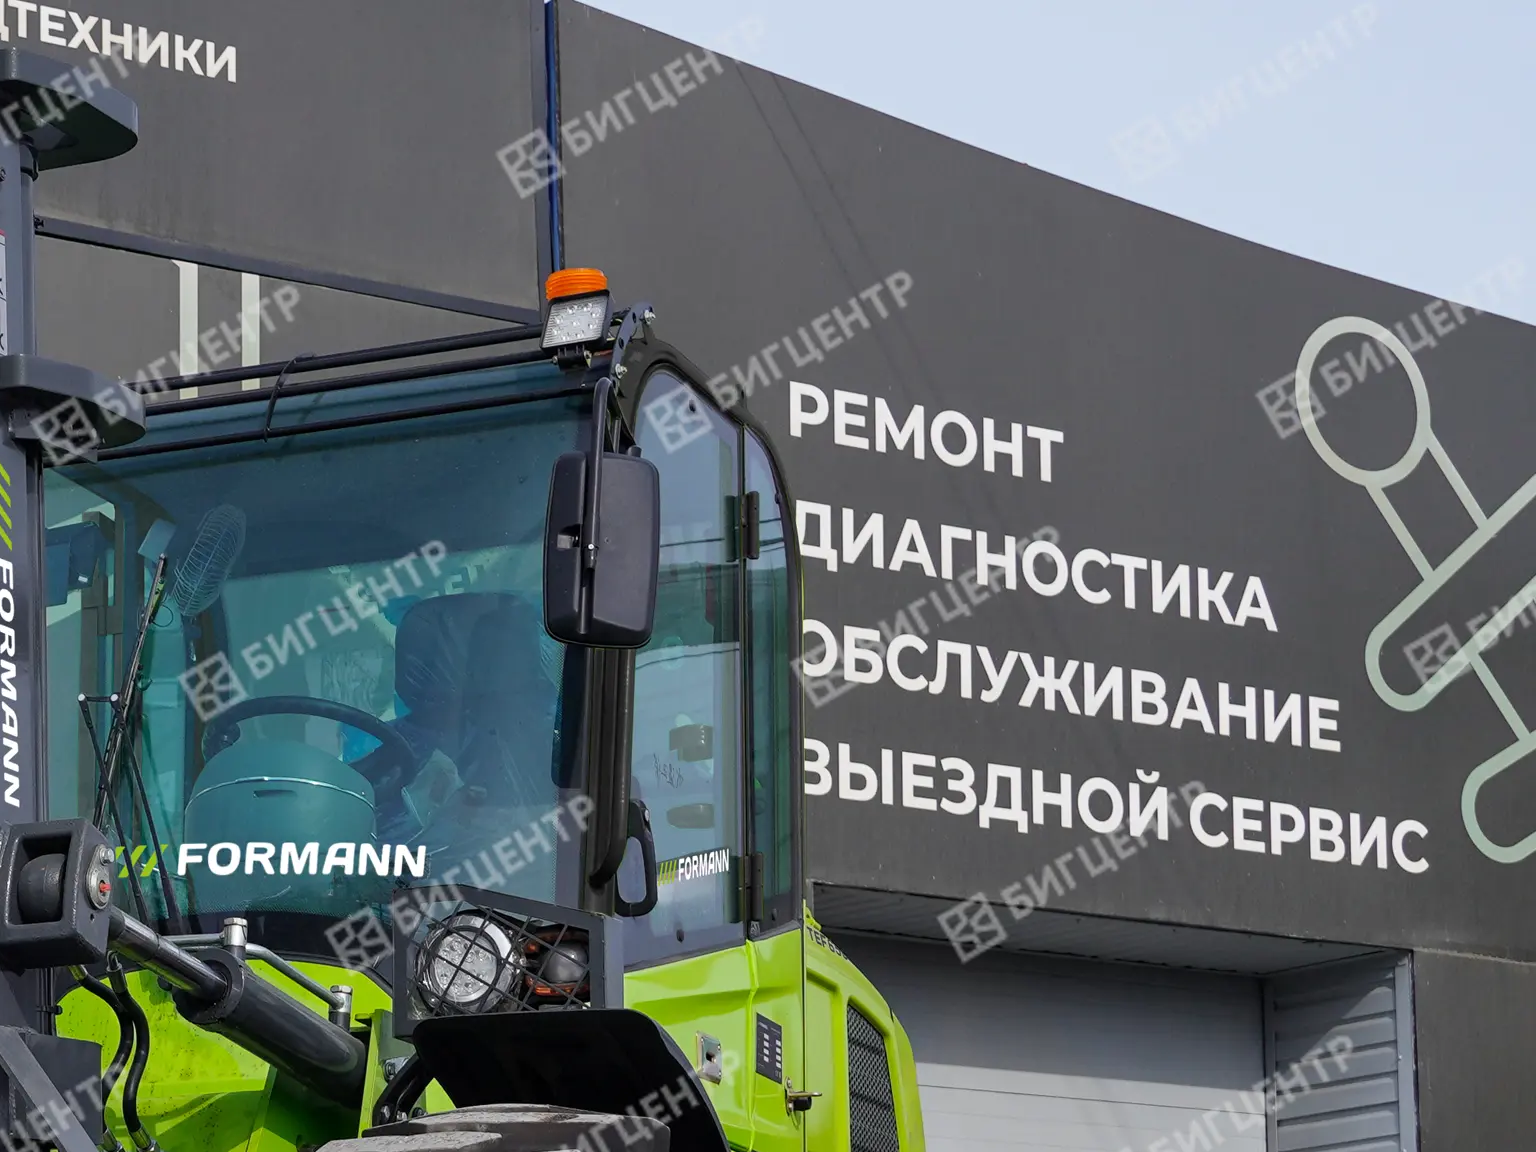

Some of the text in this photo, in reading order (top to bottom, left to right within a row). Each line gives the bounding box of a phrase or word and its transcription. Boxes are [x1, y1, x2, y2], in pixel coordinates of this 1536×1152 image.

[789, 381, 1064, 482] РЕМОНТ
[795, 499, 1278, 632] ДИАГНОСТИКА
[802, 619, 1341, 752] ОБСЛУЖИВАНИЕ
[177, 842, 427, 878] FORMANN
[678, 848, 730, 882] FORMANN
[1189, 791, 1430, 875] СЕРВИС
